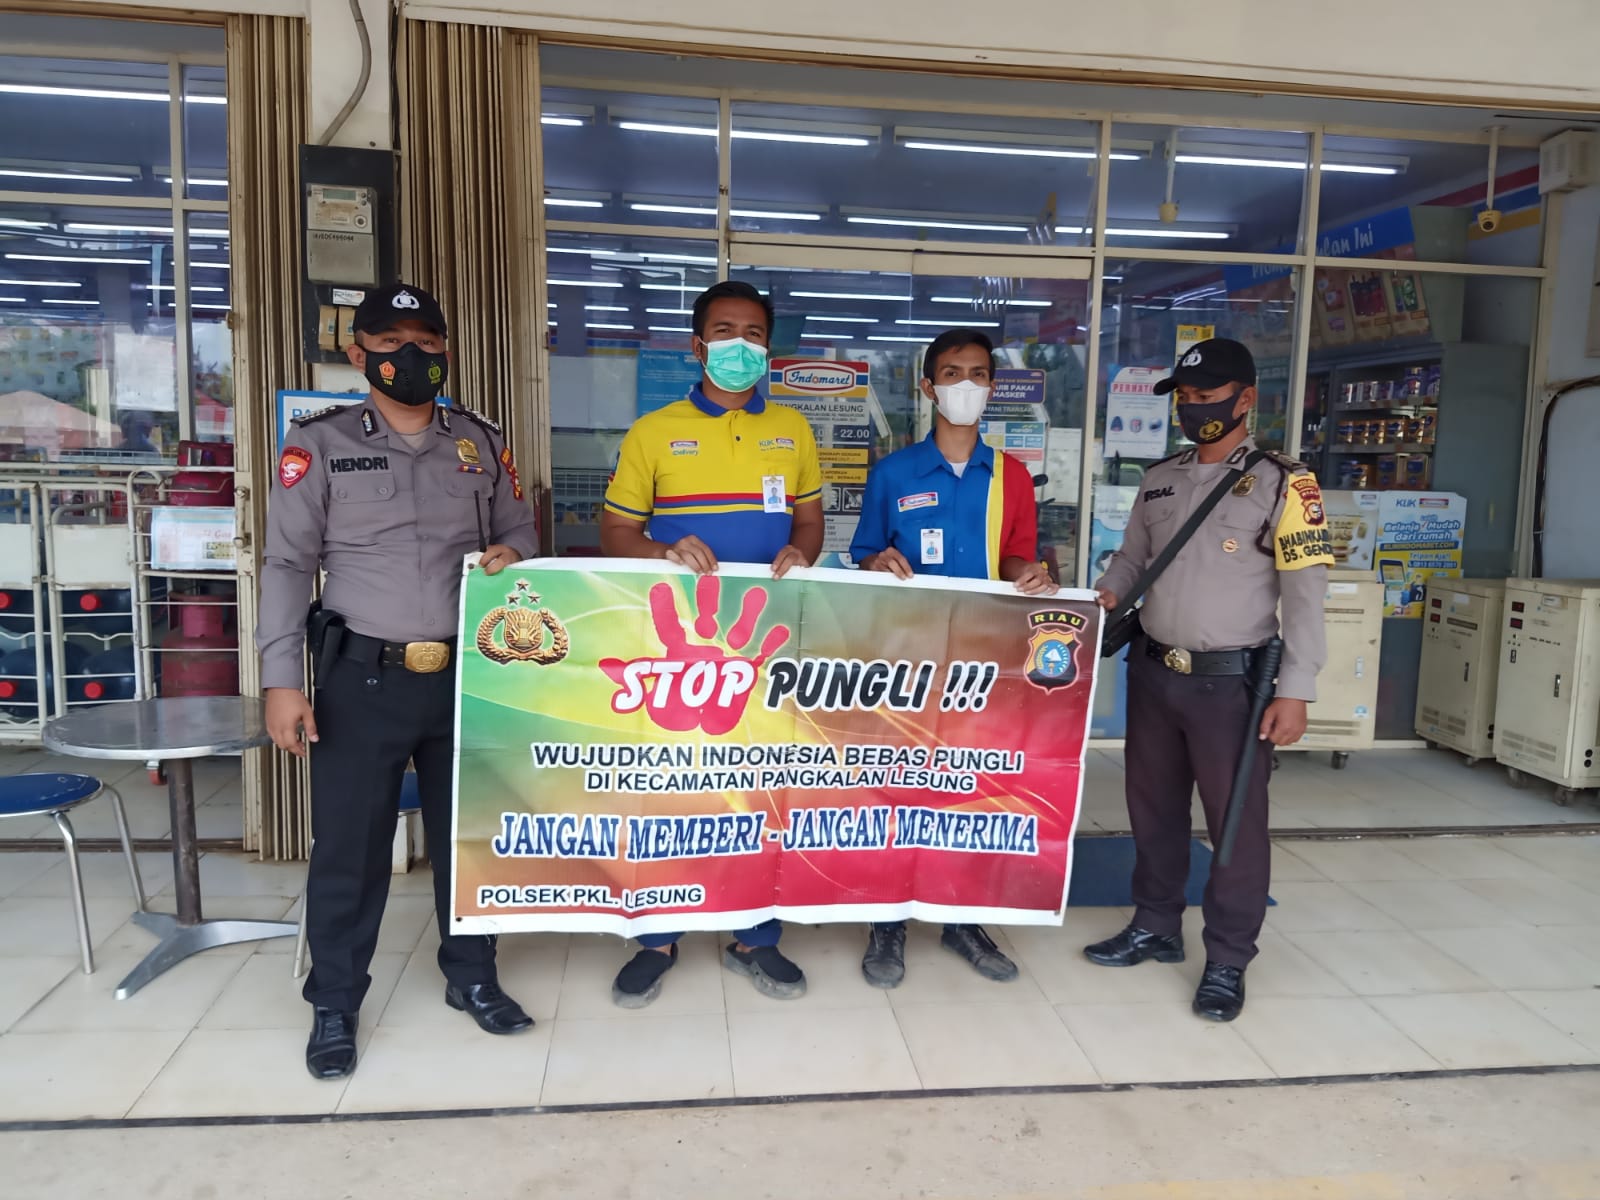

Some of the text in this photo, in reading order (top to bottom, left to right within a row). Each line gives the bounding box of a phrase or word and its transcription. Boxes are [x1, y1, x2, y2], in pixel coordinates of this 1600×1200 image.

[1354, 223, 1374, 250] Ini
[788, 371, 851, 385] Indomaret
[1112, 383, 1154, 393] PERHATI
[828, 404, 864, 413] LESUNG
[840, 428, 870, 439] 22.00
[330, 456, 389, 473] HENDRI
[1384, 520, 1460, 533] Belanja Mudah
[1395, 531, 1452, 541] dari rumah
[1283, 549, 1303, 563] DS.
[1034, 613, 1081, 626] RIAU
[615, 659, 997, 710] STOP PUNGLI !!!
[533, 745, 1023, 772] WUJUDKAN INDONESIA BEBAS PUNGLI
[587, 770, 974, 791] DI KECAMATAN PANGKALAN LESUNG
[494, 814, 620, 858] JANGAN
[627, 813, 765, 860] MEMBERI
[783, 808, 889, 850] JANGAN
[894, 808, 1037, 853] MENERIMA
[480, 887, 702, 909] POLSEK PKL. LESUNG
